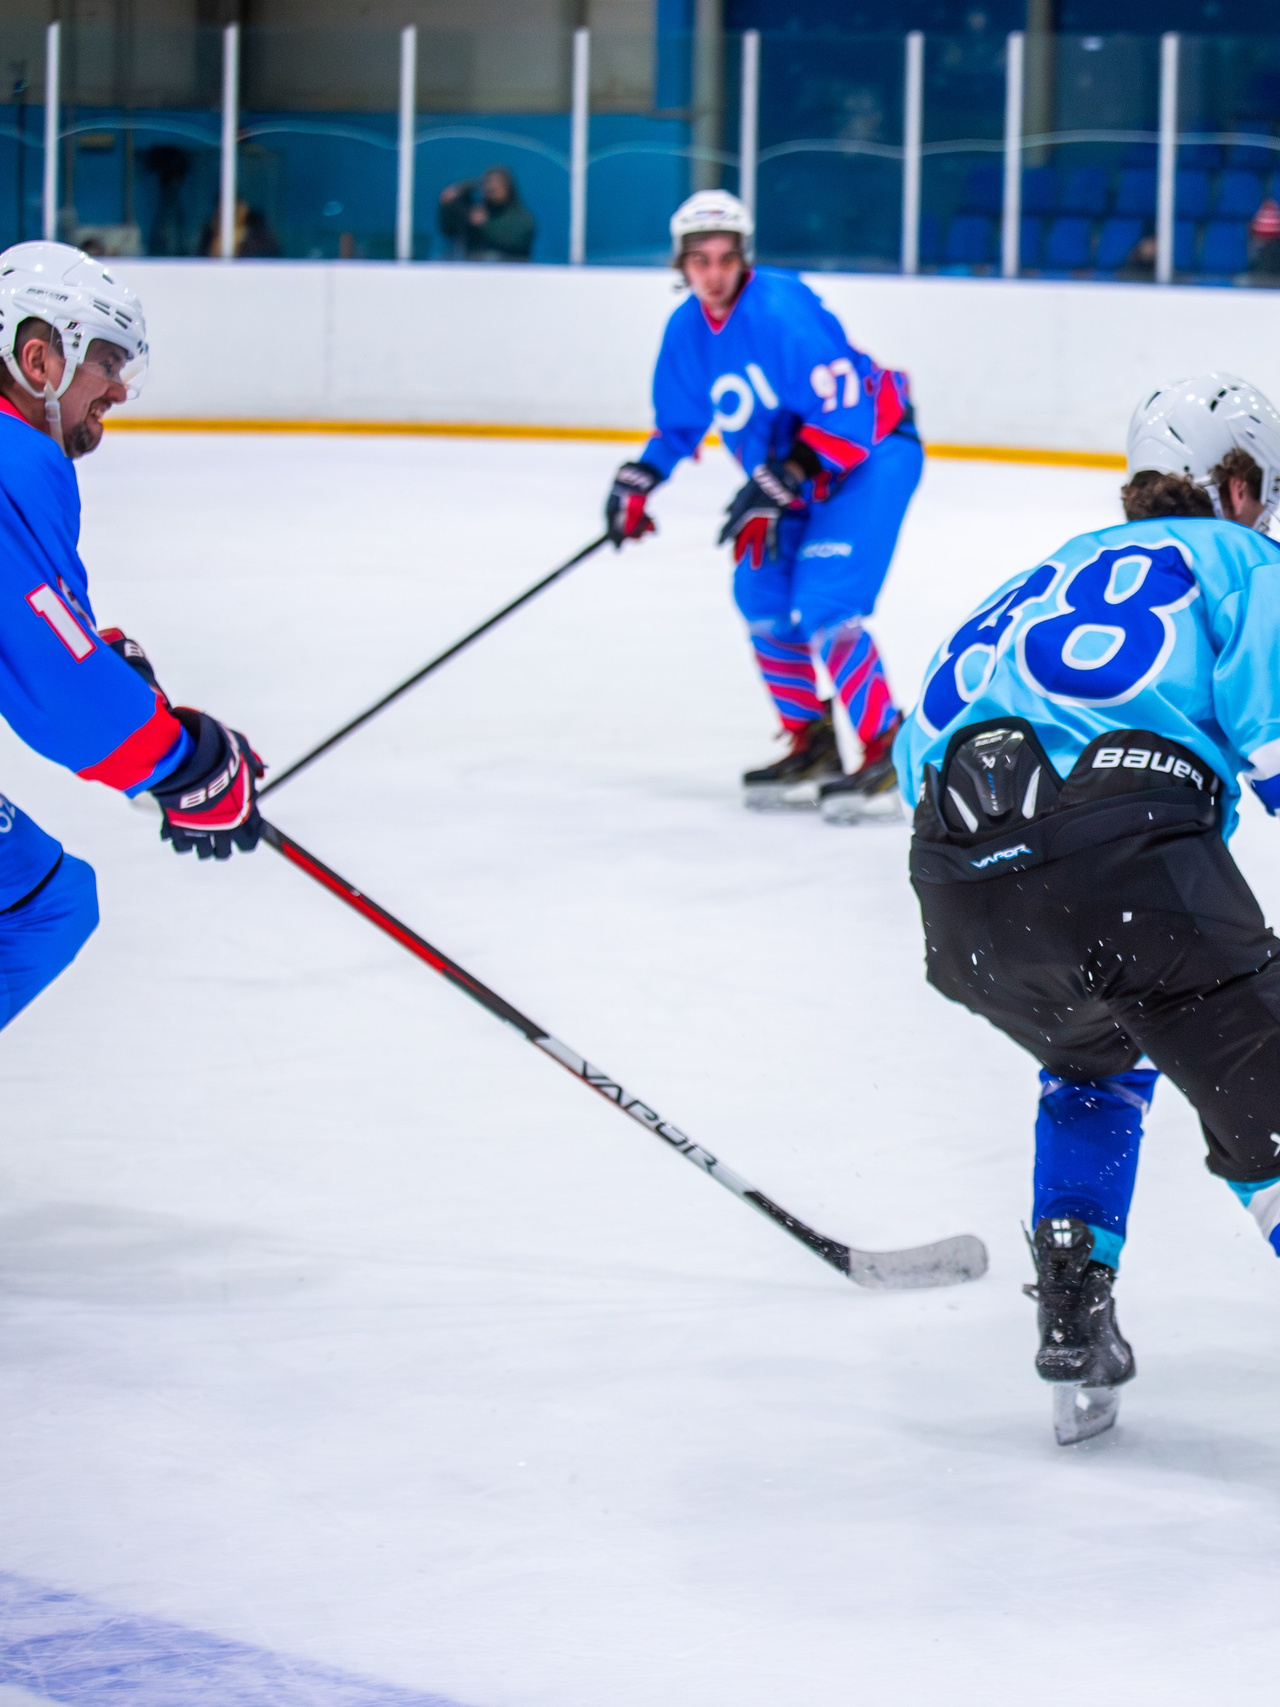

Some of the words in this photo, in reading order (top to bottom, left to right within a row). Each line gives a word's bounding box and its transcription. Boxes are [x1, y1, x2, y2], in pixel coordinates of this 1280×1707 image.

[809, 356, 861, 413] 97
[917, 538, 1200, 740] 88
[969, 843, 1033, 870] VAPOR
[581, 1059, 719, 1175] VAPOR
